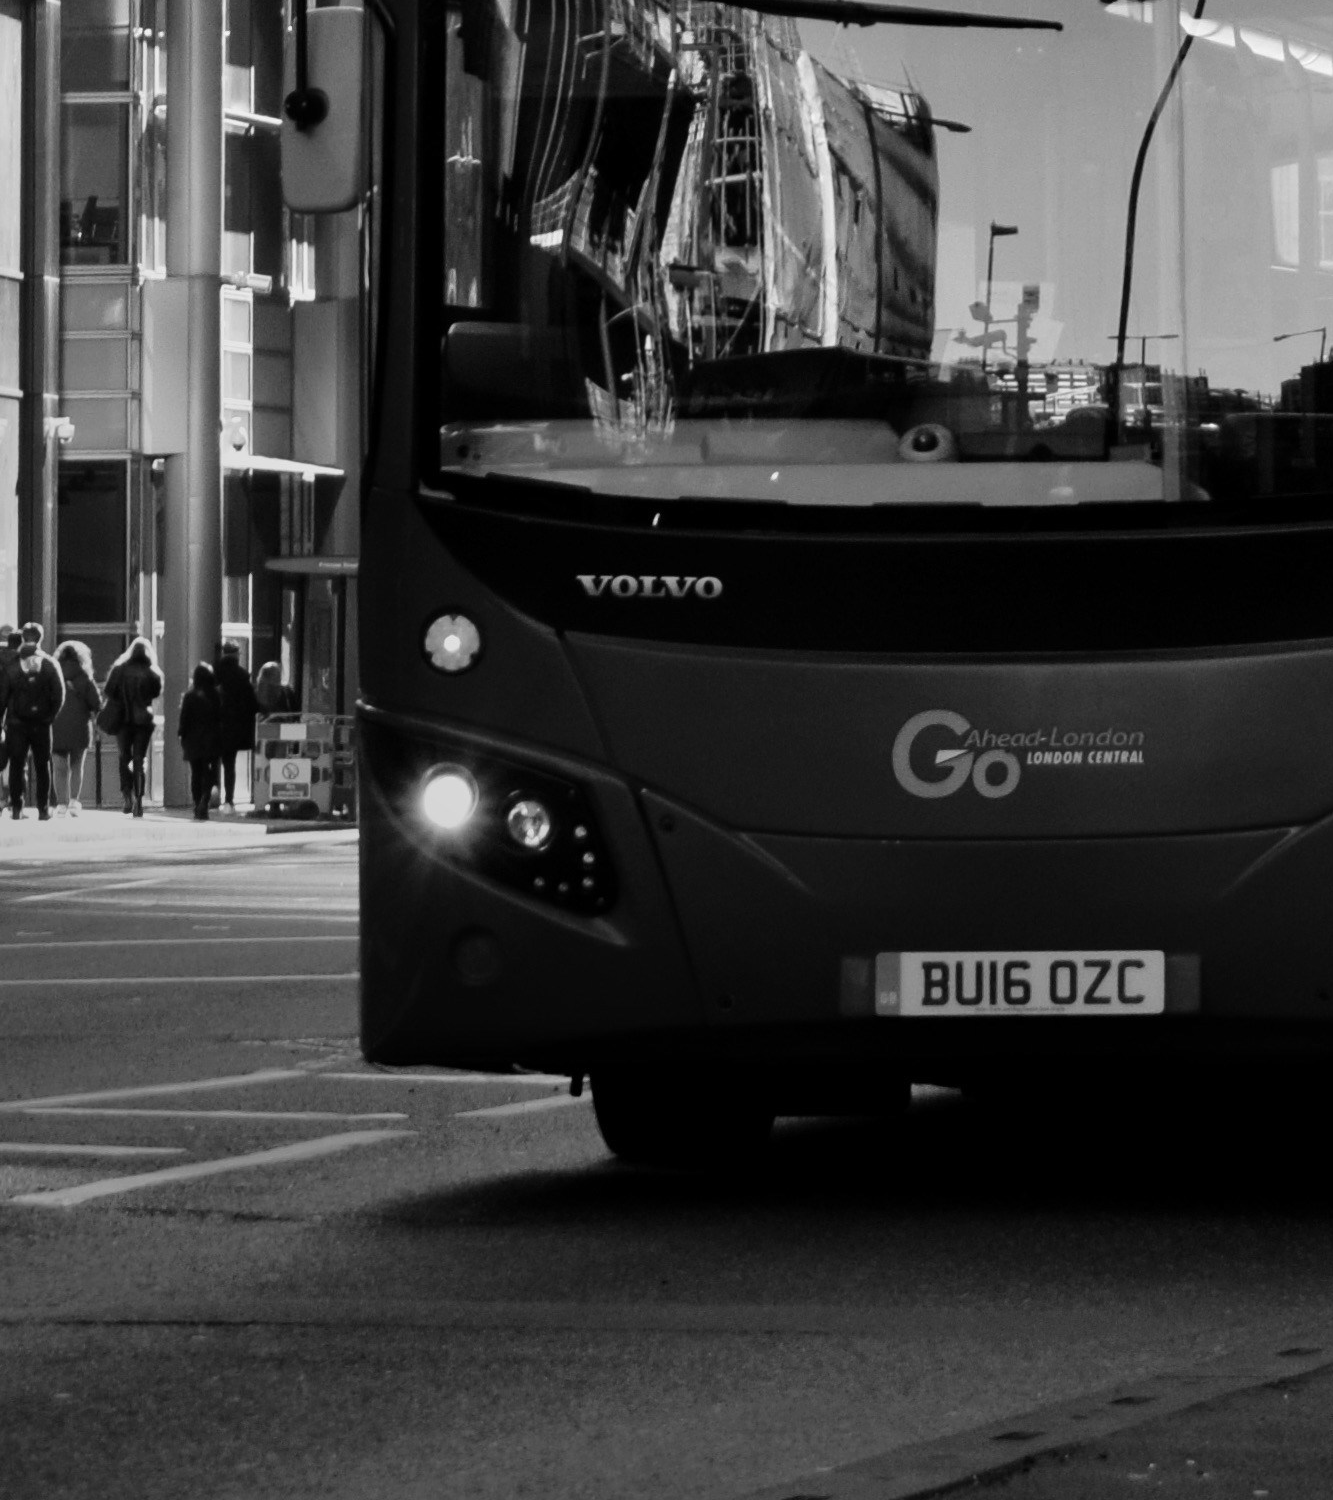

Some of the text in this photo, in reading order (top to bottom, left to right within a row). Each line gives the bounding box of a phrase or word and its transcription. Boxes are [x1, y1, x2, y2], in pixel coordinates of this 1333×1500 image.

[576, 574, 724, 596] VOLVO
[964, 726, 1146, 747] Ahead-London
[892, 709, 1021, 799] Go
[1026, 750, 1145, 765] LONDON CENTRAL
[921, 959, 1145, 1005] BU16 OZC
